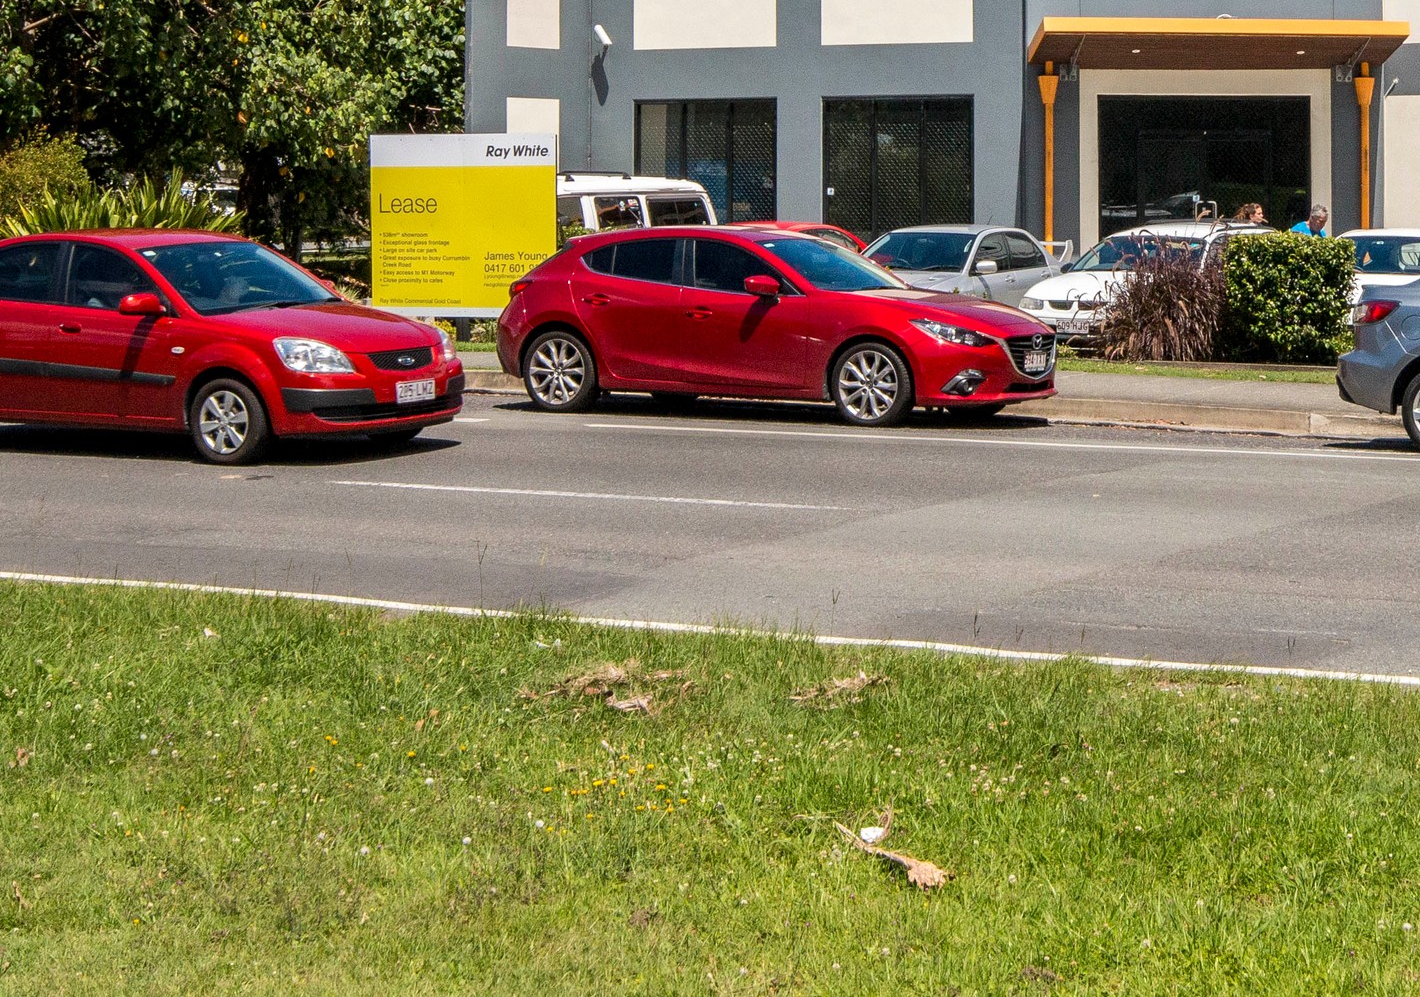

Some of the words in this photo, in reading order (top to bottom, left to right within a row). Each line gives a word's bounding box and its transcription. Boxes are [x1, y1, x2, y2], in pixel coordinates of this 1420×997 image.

[486, 145, 510, 159] Ray
[513, 145, 549, 157] White
[379, 193, 437, 214] Lease
[484, 251, 515, 261] James
[484, 263, 507, 273] 0417
[509, 263, 525, 273] 601
